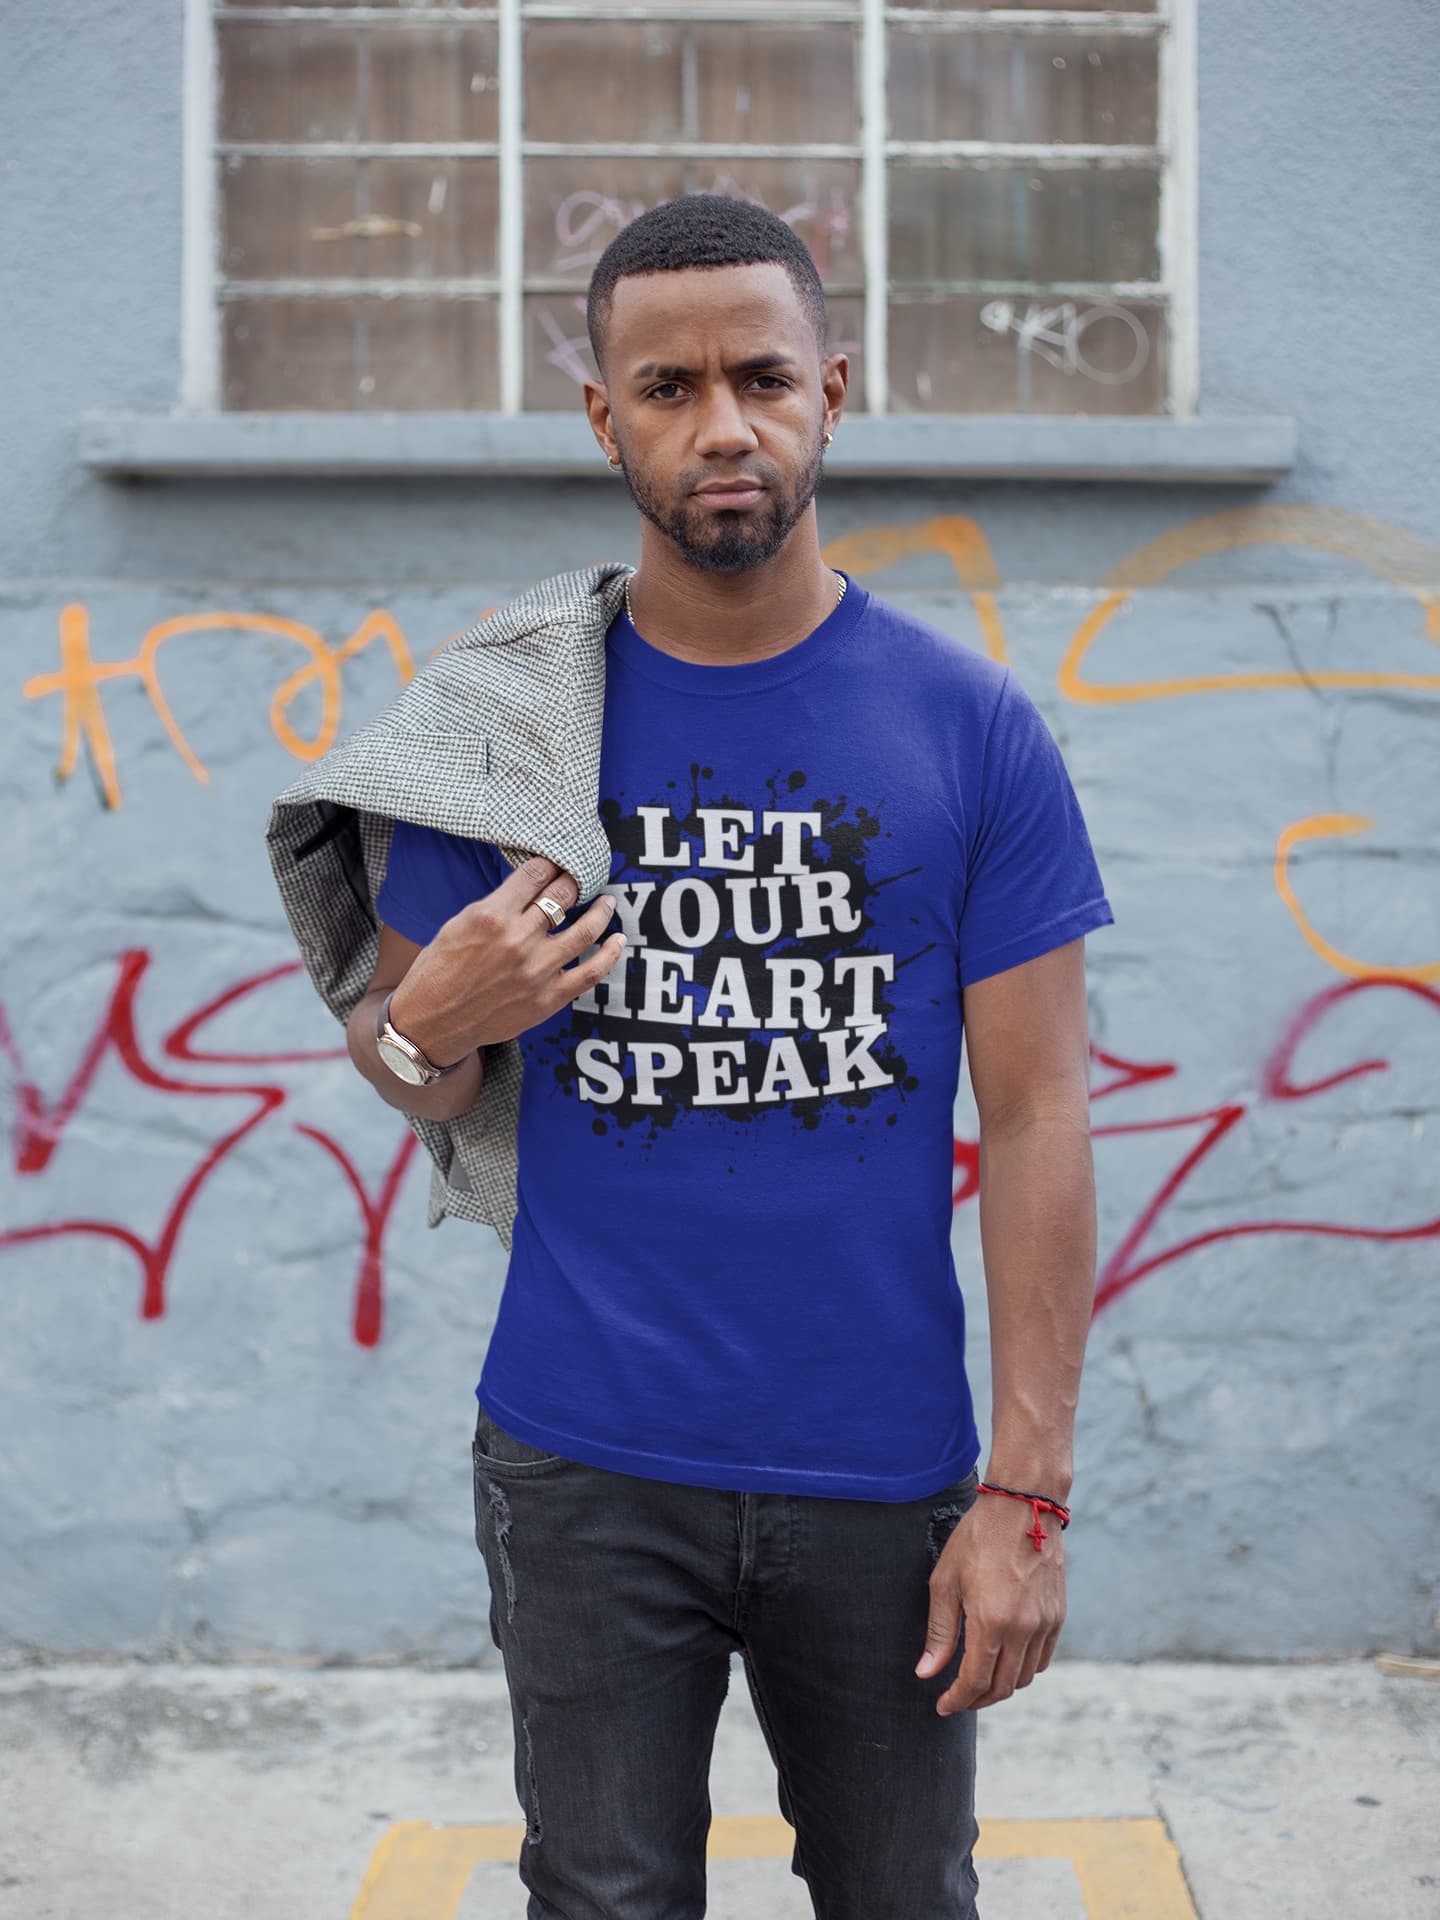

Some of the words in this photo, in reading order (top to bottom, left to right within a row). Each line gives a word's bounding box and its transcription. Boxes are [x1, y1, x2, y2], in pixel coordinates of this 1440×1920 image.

[637, 806, 822, 875] LET
[604, 870, 862, 948] YOUR
[575, 1022, 895, 1106] SPEAK
